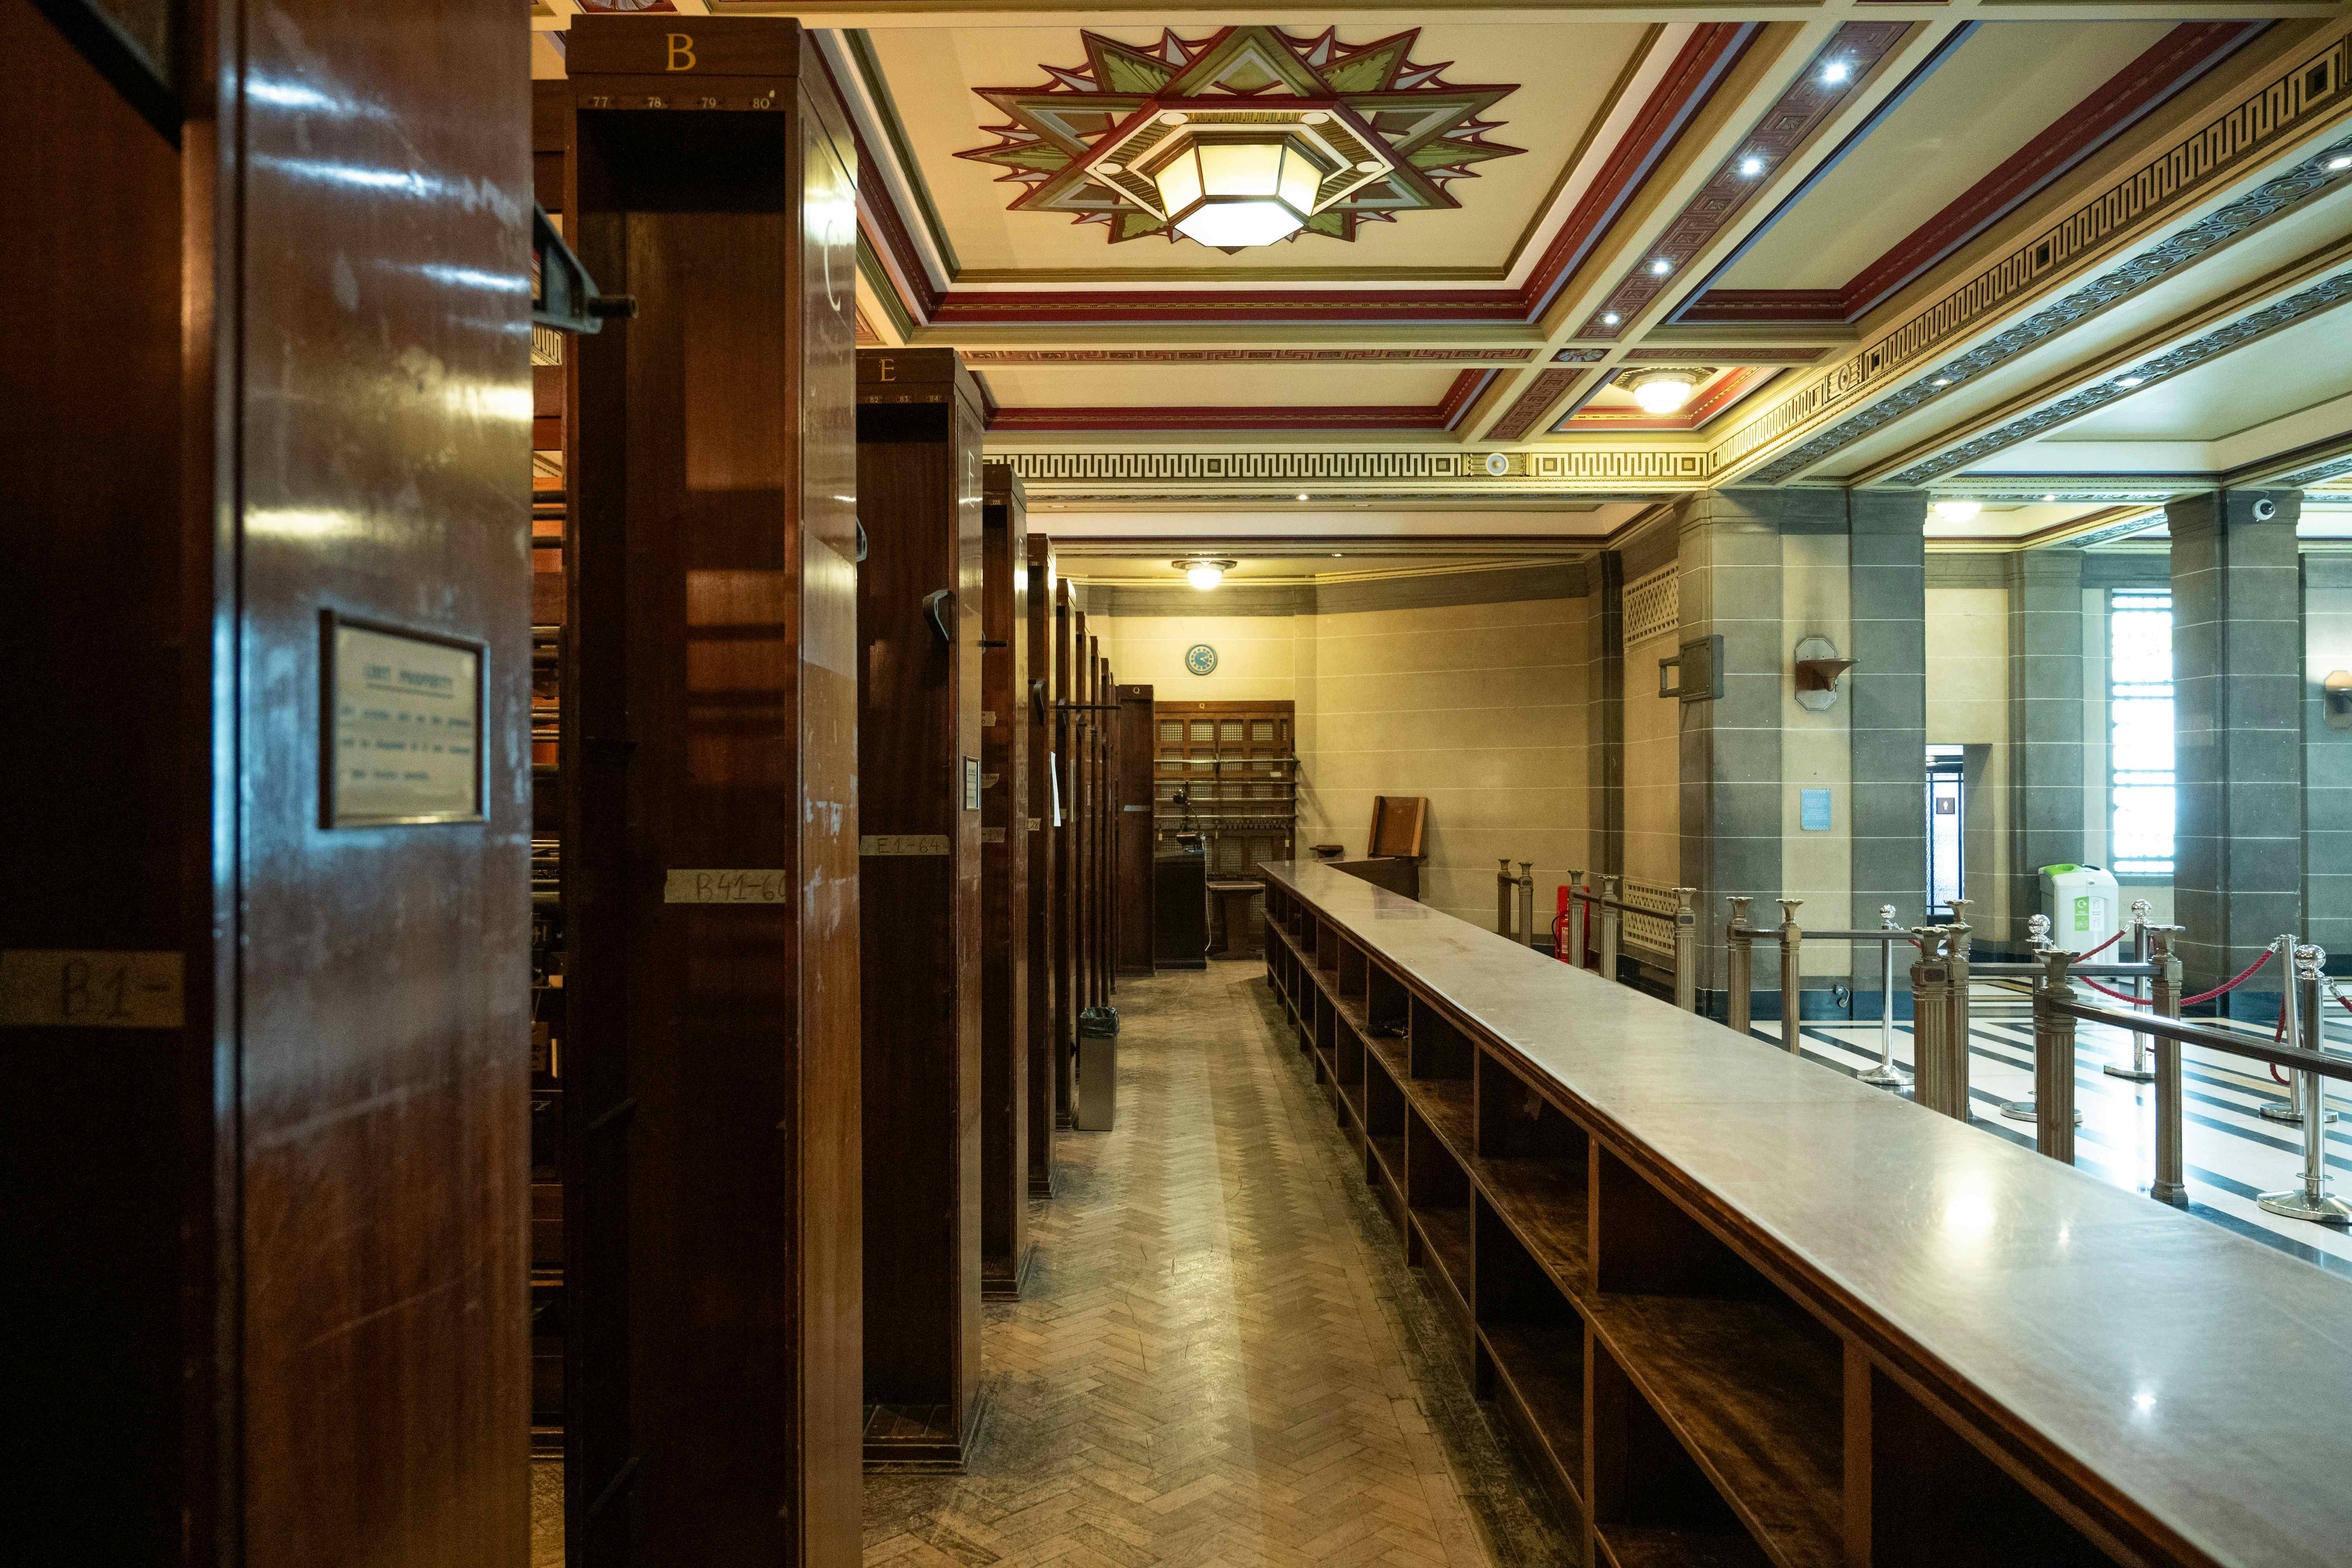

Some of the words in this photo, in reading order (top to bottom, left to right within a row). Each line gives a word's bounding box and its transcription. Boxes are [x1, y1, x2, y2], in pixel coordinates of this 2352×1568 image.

[665, 33, 697, 71] B
[593, 96, 609, 108] 77
[647, 96, 662, 108] 78
[702, 96, 717, 108] 79
[752, 98, 770, 109] 80
[880, 358, 896, 382] E
[1133, 687, 1140, 695] Q
